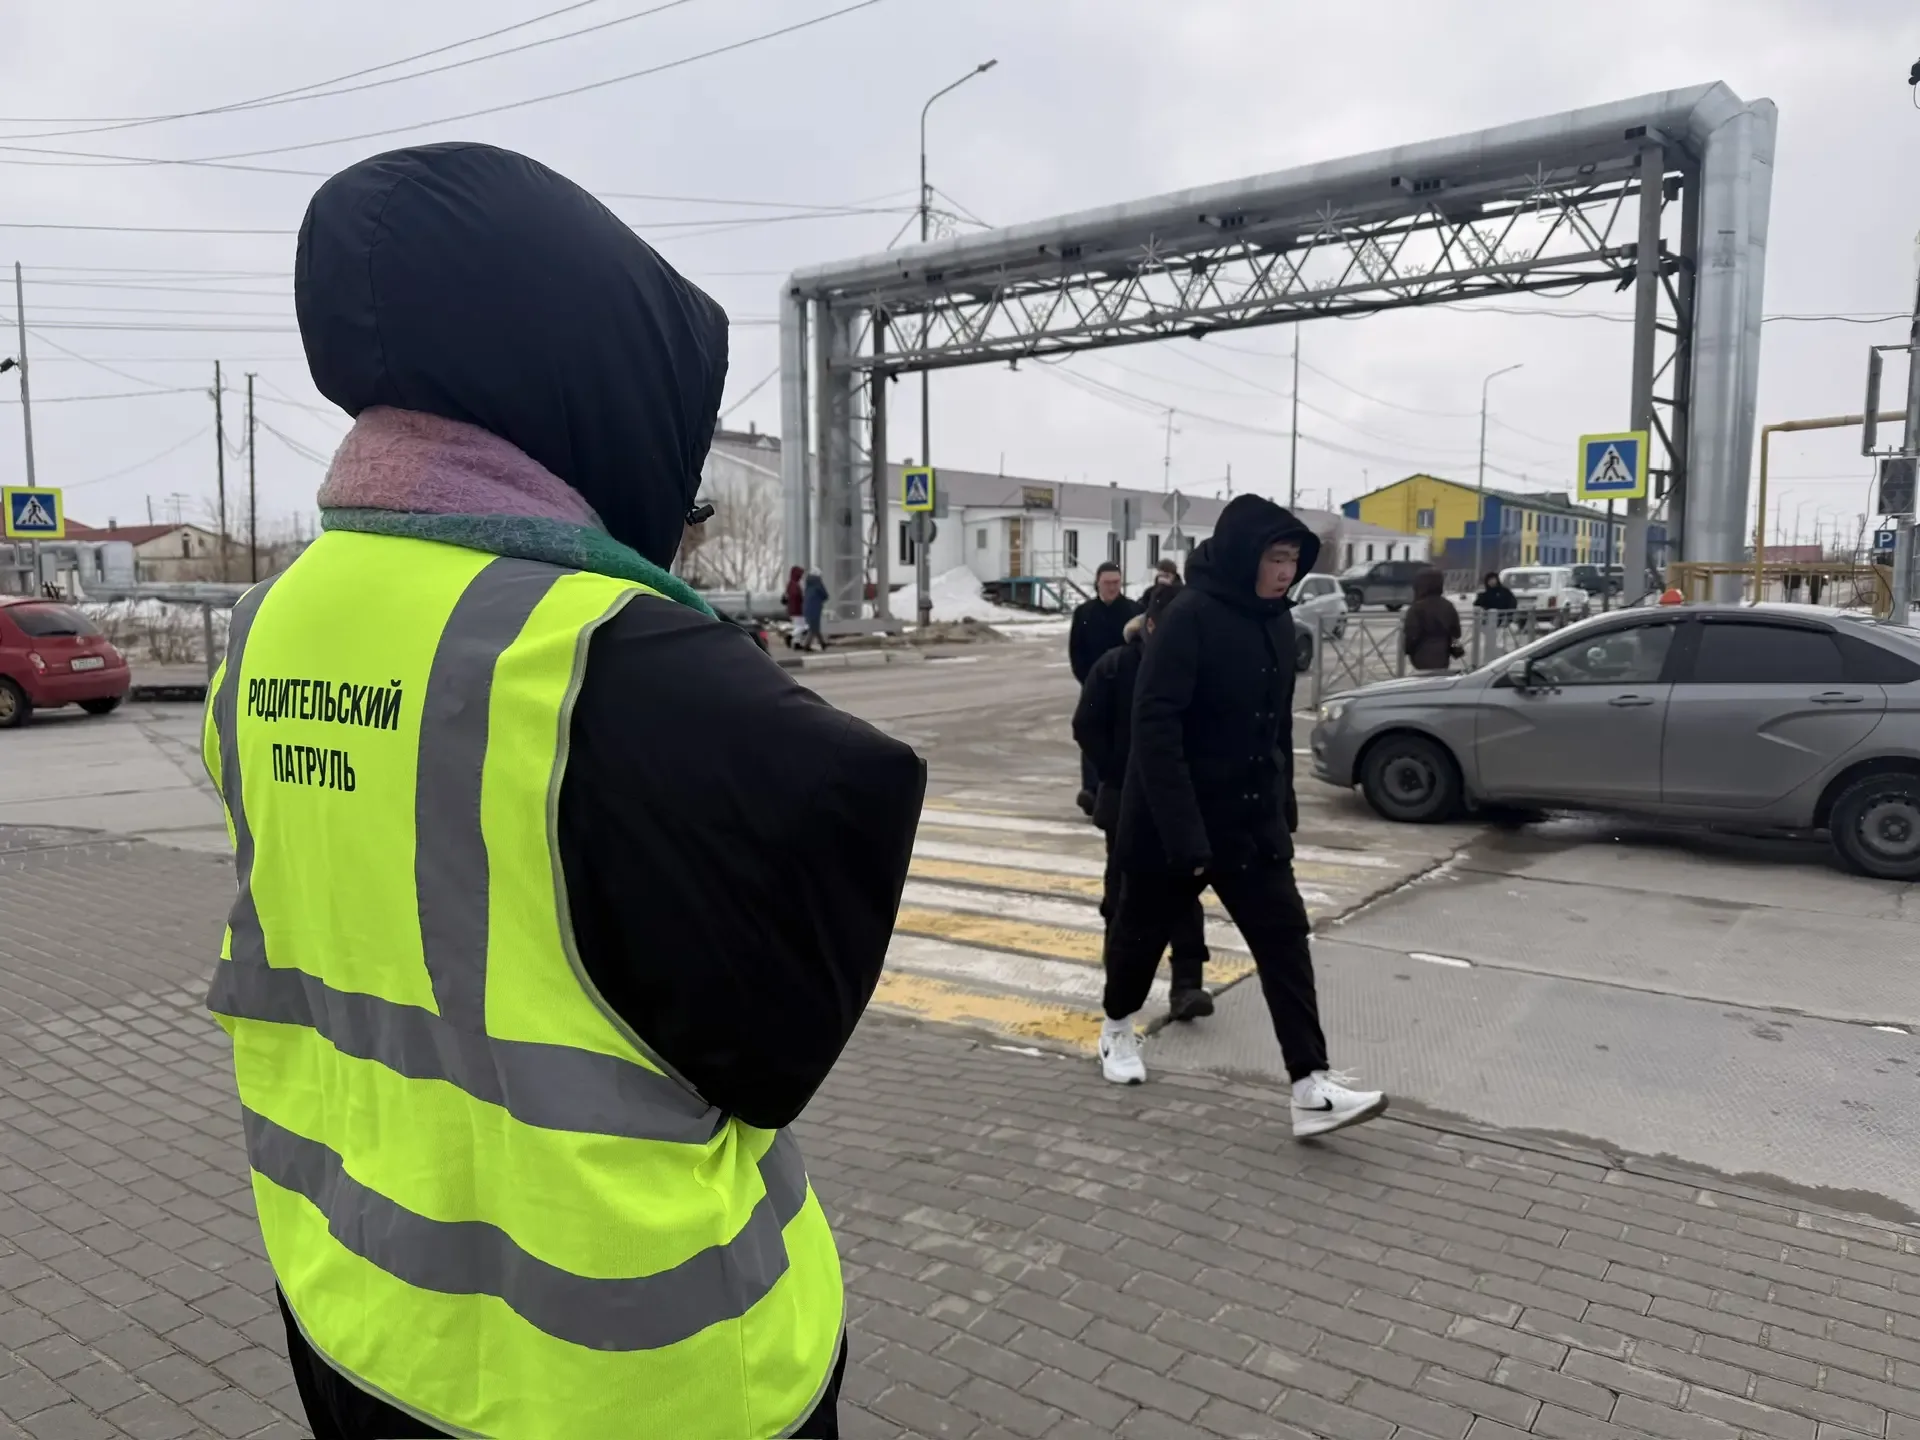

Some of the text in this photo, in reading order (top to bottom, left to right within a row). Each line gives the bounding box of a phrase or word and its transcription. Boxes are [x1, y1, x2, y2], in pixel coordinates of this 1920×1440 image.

[1879, 531, 1892, 547] P
[248, 678, 402, 730] РОДИТЕЛЬСКИЙ
[272, 743, 356, 792] ПАТРУЛЬ
